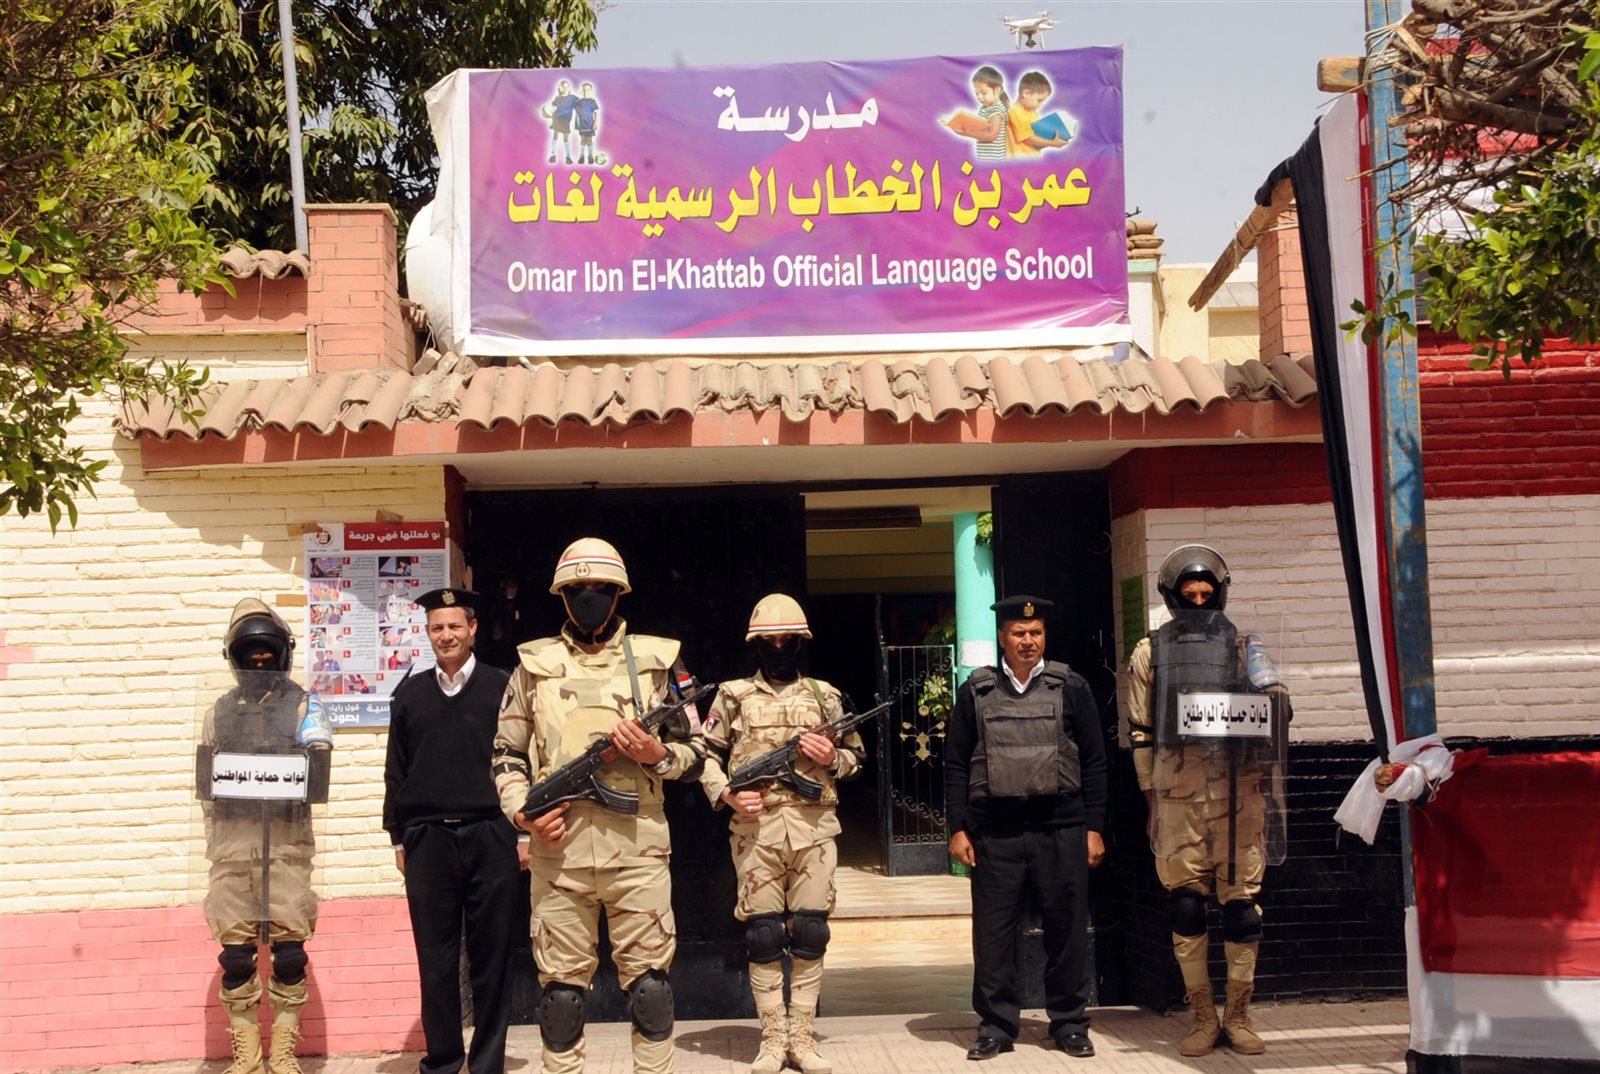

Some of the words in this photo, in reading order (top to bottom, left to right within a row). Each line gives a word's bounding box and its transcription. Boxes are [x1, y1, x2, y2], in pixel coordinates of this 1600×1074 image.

[713, 84, 880, 143] مدرسة
[507, 170, 604, 223] لغات
[611, 163, 777, 238] الرسمية
[787, 160, 942, 233] الخطاب
[952, 161, 1002, 230] بن
[1008, 166, 1092, 224] عمر
[506, 261, 578, 293] Omar
[584, 261, 624, 293] Ibn
[631, 256, 766, 292] El-Khattab
[772, 253, 864, 288] Official
[871, 257, 998, 291] Language
[1004, 246, 1093, 282] School
[348, 530, 375, 542] جريمة
[377, 531, 398, 543] فهي
[400, 530, 430, 541] فعلتها
[1183, 703, 1219, 729] المواطنين
[1220, 702, 1247, 729] حماية
[1249, 703, 1268, 728] قوات
[212, 769, 251, 784] المواطنين
[254, 769, 279, 785] حماية
[282, 771, 305, 785] قوات
